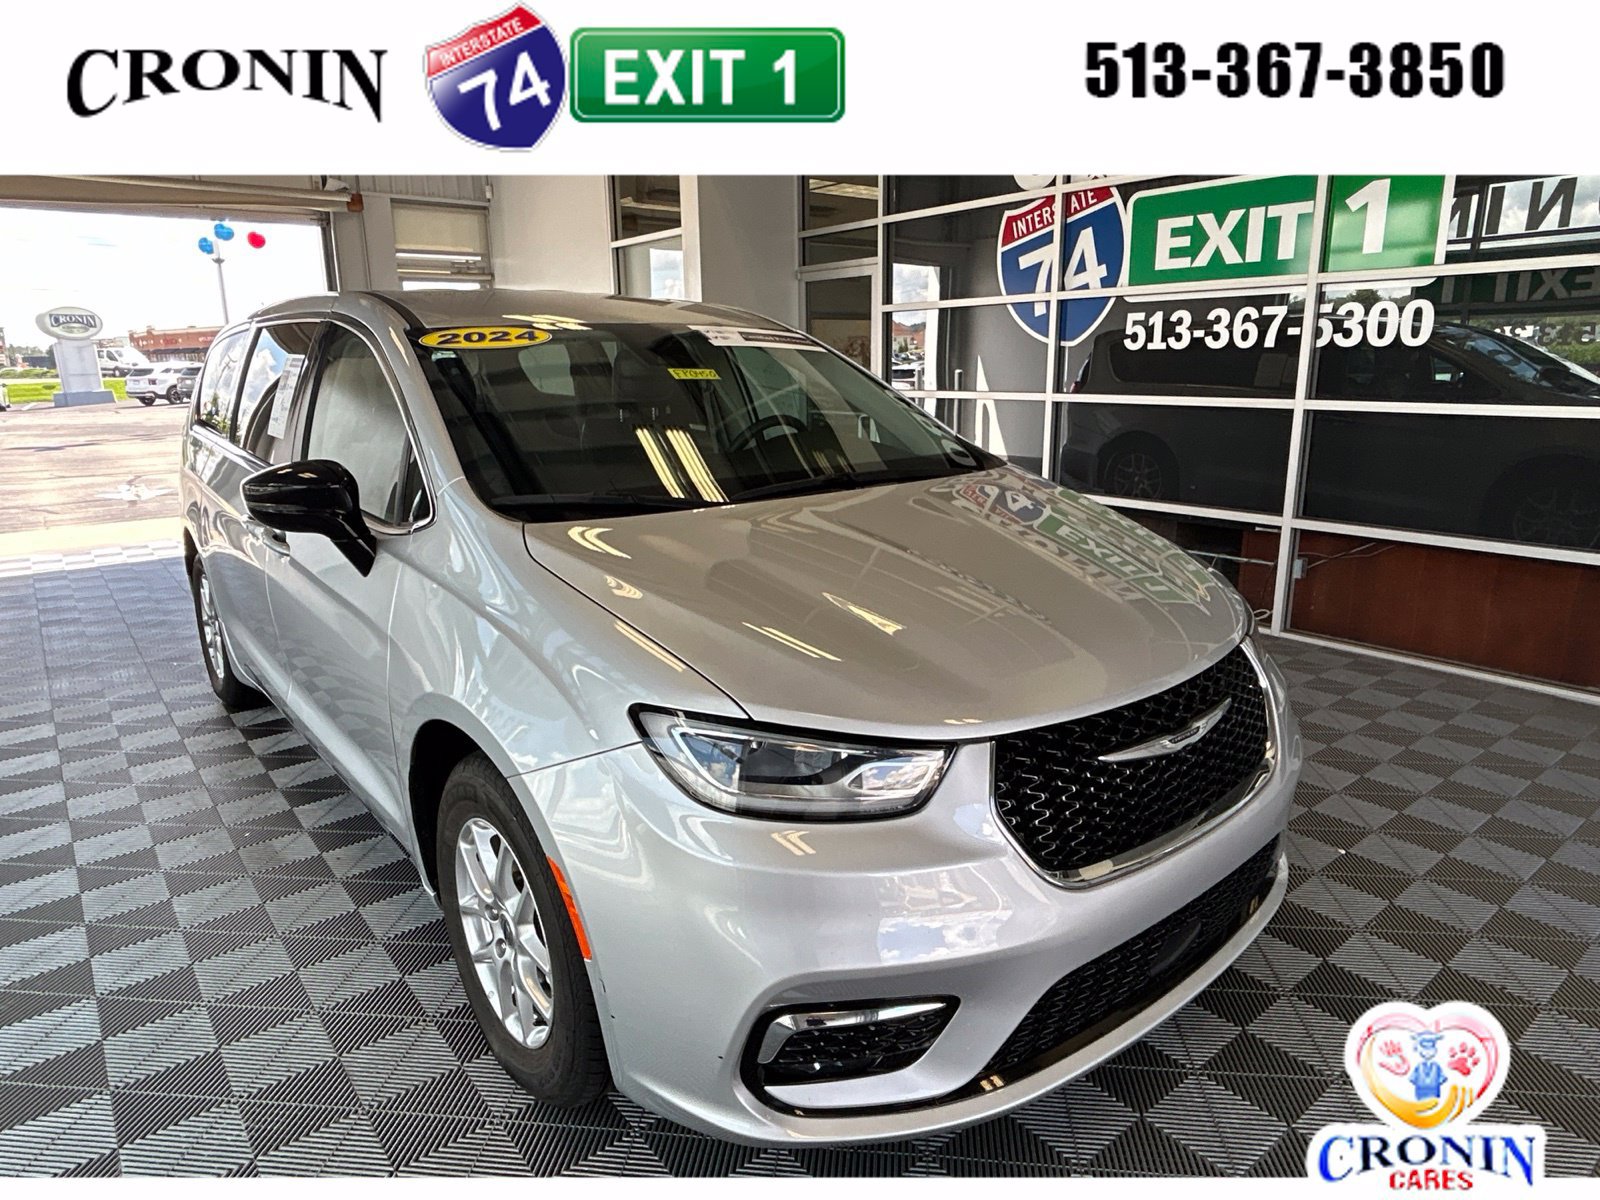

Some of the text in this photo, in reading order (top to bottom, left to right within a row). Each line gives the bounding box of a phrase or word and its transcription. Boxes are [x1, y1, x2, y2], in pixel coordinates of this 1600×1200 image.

[1011, 189, 1099, 239] INTERATE
[1154, 178, 1392, 271] EXIT 1
[1018, 226, 1108, 317] 74
[51, 314, 96, 328] CRONIN
[436, 331, 539, 345] 2024
[1122, 299, 1436, 350] 513-367-5300
